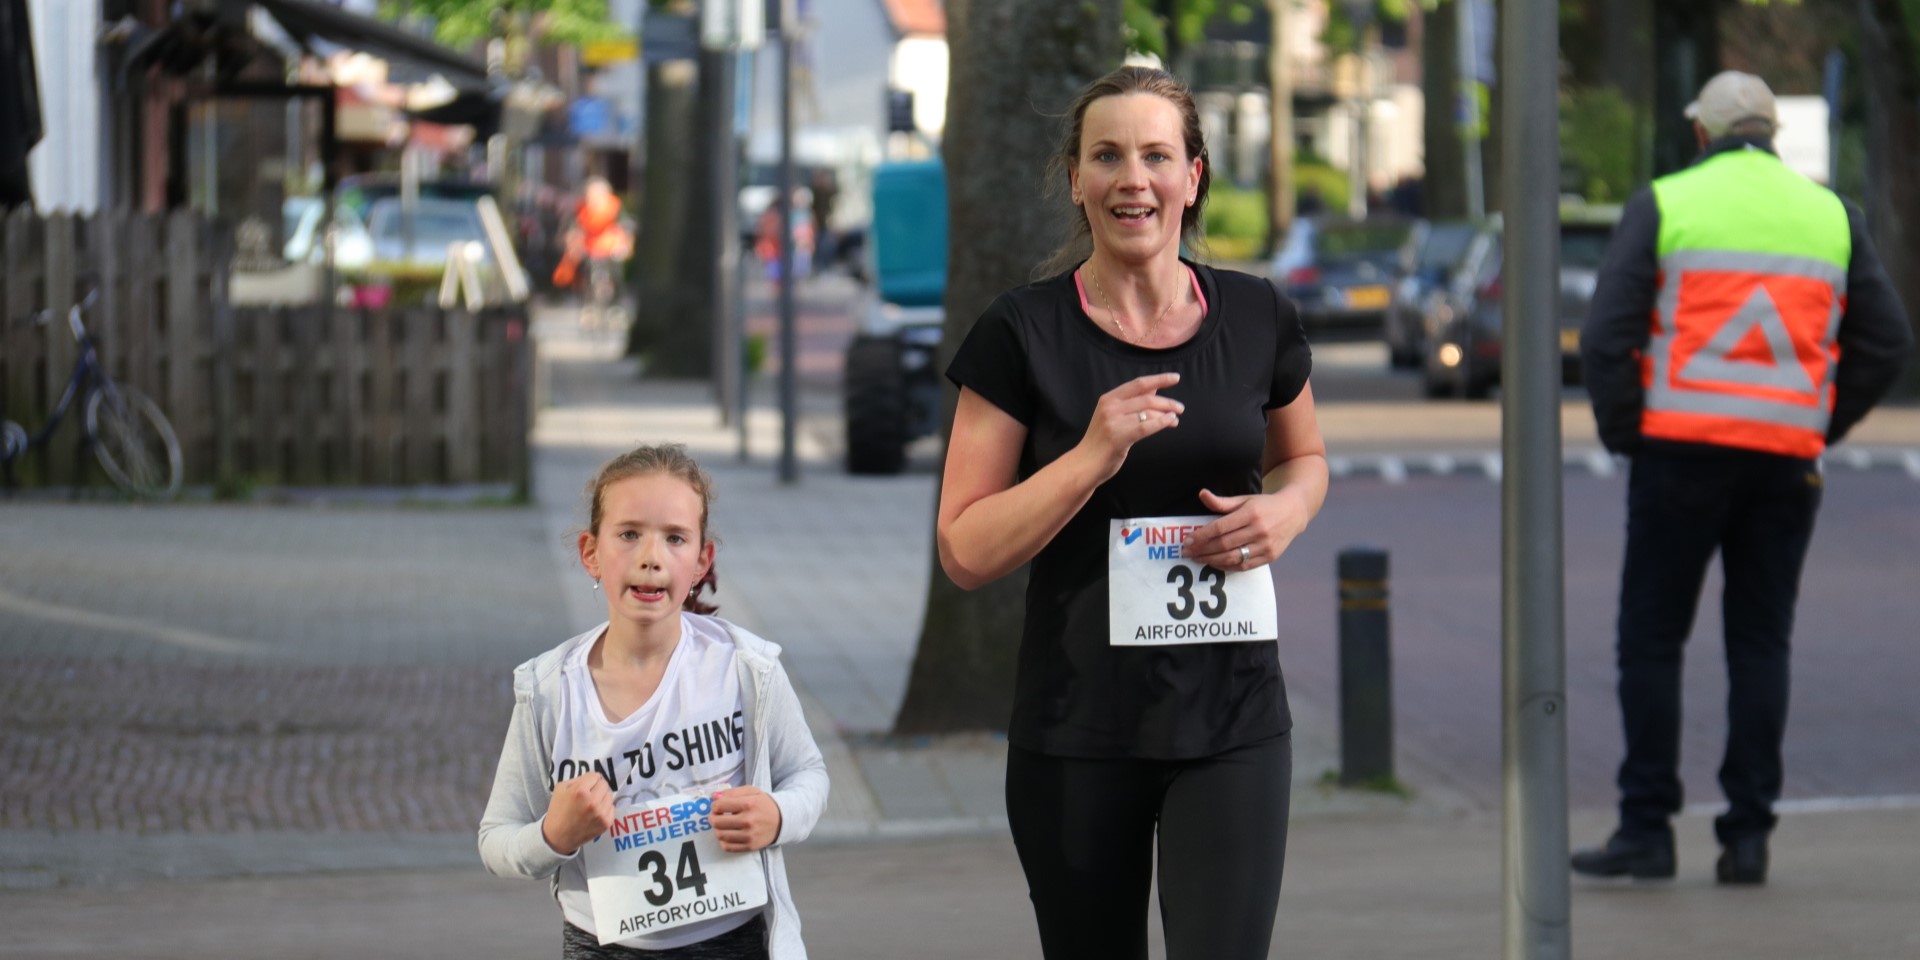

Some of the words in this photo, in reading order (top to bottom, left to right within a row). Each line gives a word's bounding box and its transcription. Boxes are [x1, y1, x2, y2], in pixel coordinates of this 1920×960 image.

[1145, 524, 1204, 545] INTE
[1166, 564, 1228, 621] 33
[1135, 621, 1258, 640] AIRFORYOU.NL
[623, 742, 656, 785] TO
[662, 711, 744, 771] SHINE
[610, 797, 714, 838] INTERSPO
[614, 816, 712, 852] MEIJERS
[638, 840, 708, 907] 34
[619, 891, 746, 934] AIRFORYOU.NL
